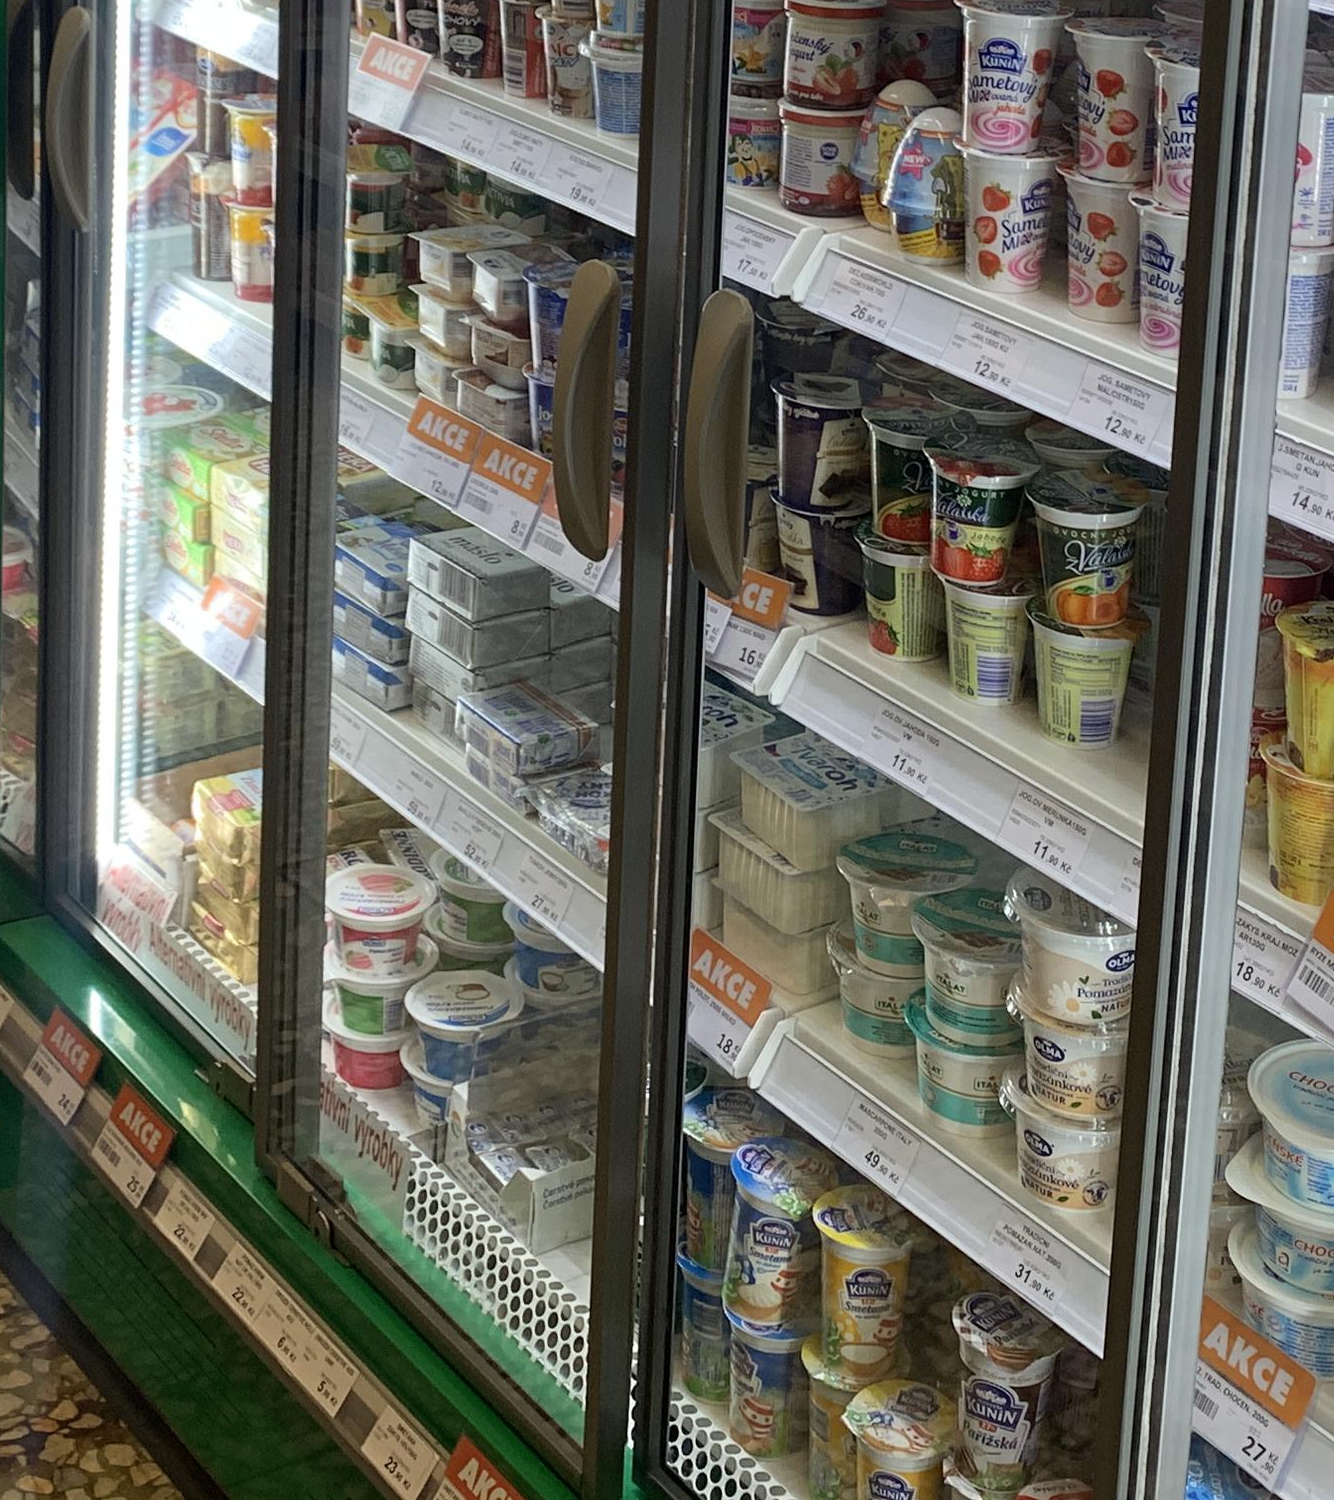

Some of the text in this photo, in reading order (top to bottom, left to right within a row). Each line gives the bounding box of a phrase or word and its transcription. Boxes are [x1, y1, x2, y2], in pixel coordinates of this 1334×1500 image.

[369, 48, 417, 81] AKCE
[973, 360, 1000, 383] 12,90
[416, 410, 469, 453] AKCE
[1104, 415, 1134, 441] 12,90
[484, 449, 538, 491] AKCE
[1291, 491, 1324, 517] 14,90
[788, 743, 858, 794] Tvaroh
[891, 752, 928, 785] 11,90 Kč
[1032, 839, 1073, 876] 11,90 Kč
[694, 948, 757, 1008] AKCE
[1235, 961, 1282, 999] 18,90 Kč
[50, 1025, 91, 1076] AKCE
[1037, 1040, 1063, 1058] OLMA
[119, 1101, 161, 1154] AKCE
[865, 1149, 900, 1185] 49,90 Kč
[1014, 1263, 1056, 1301] 31,90 Kč
[1202, 1323, 1296, 1406] AKCE
[1252, 1407, 1270, 1428] 200G
[1267, 1451, 1279, 1465] Kč
